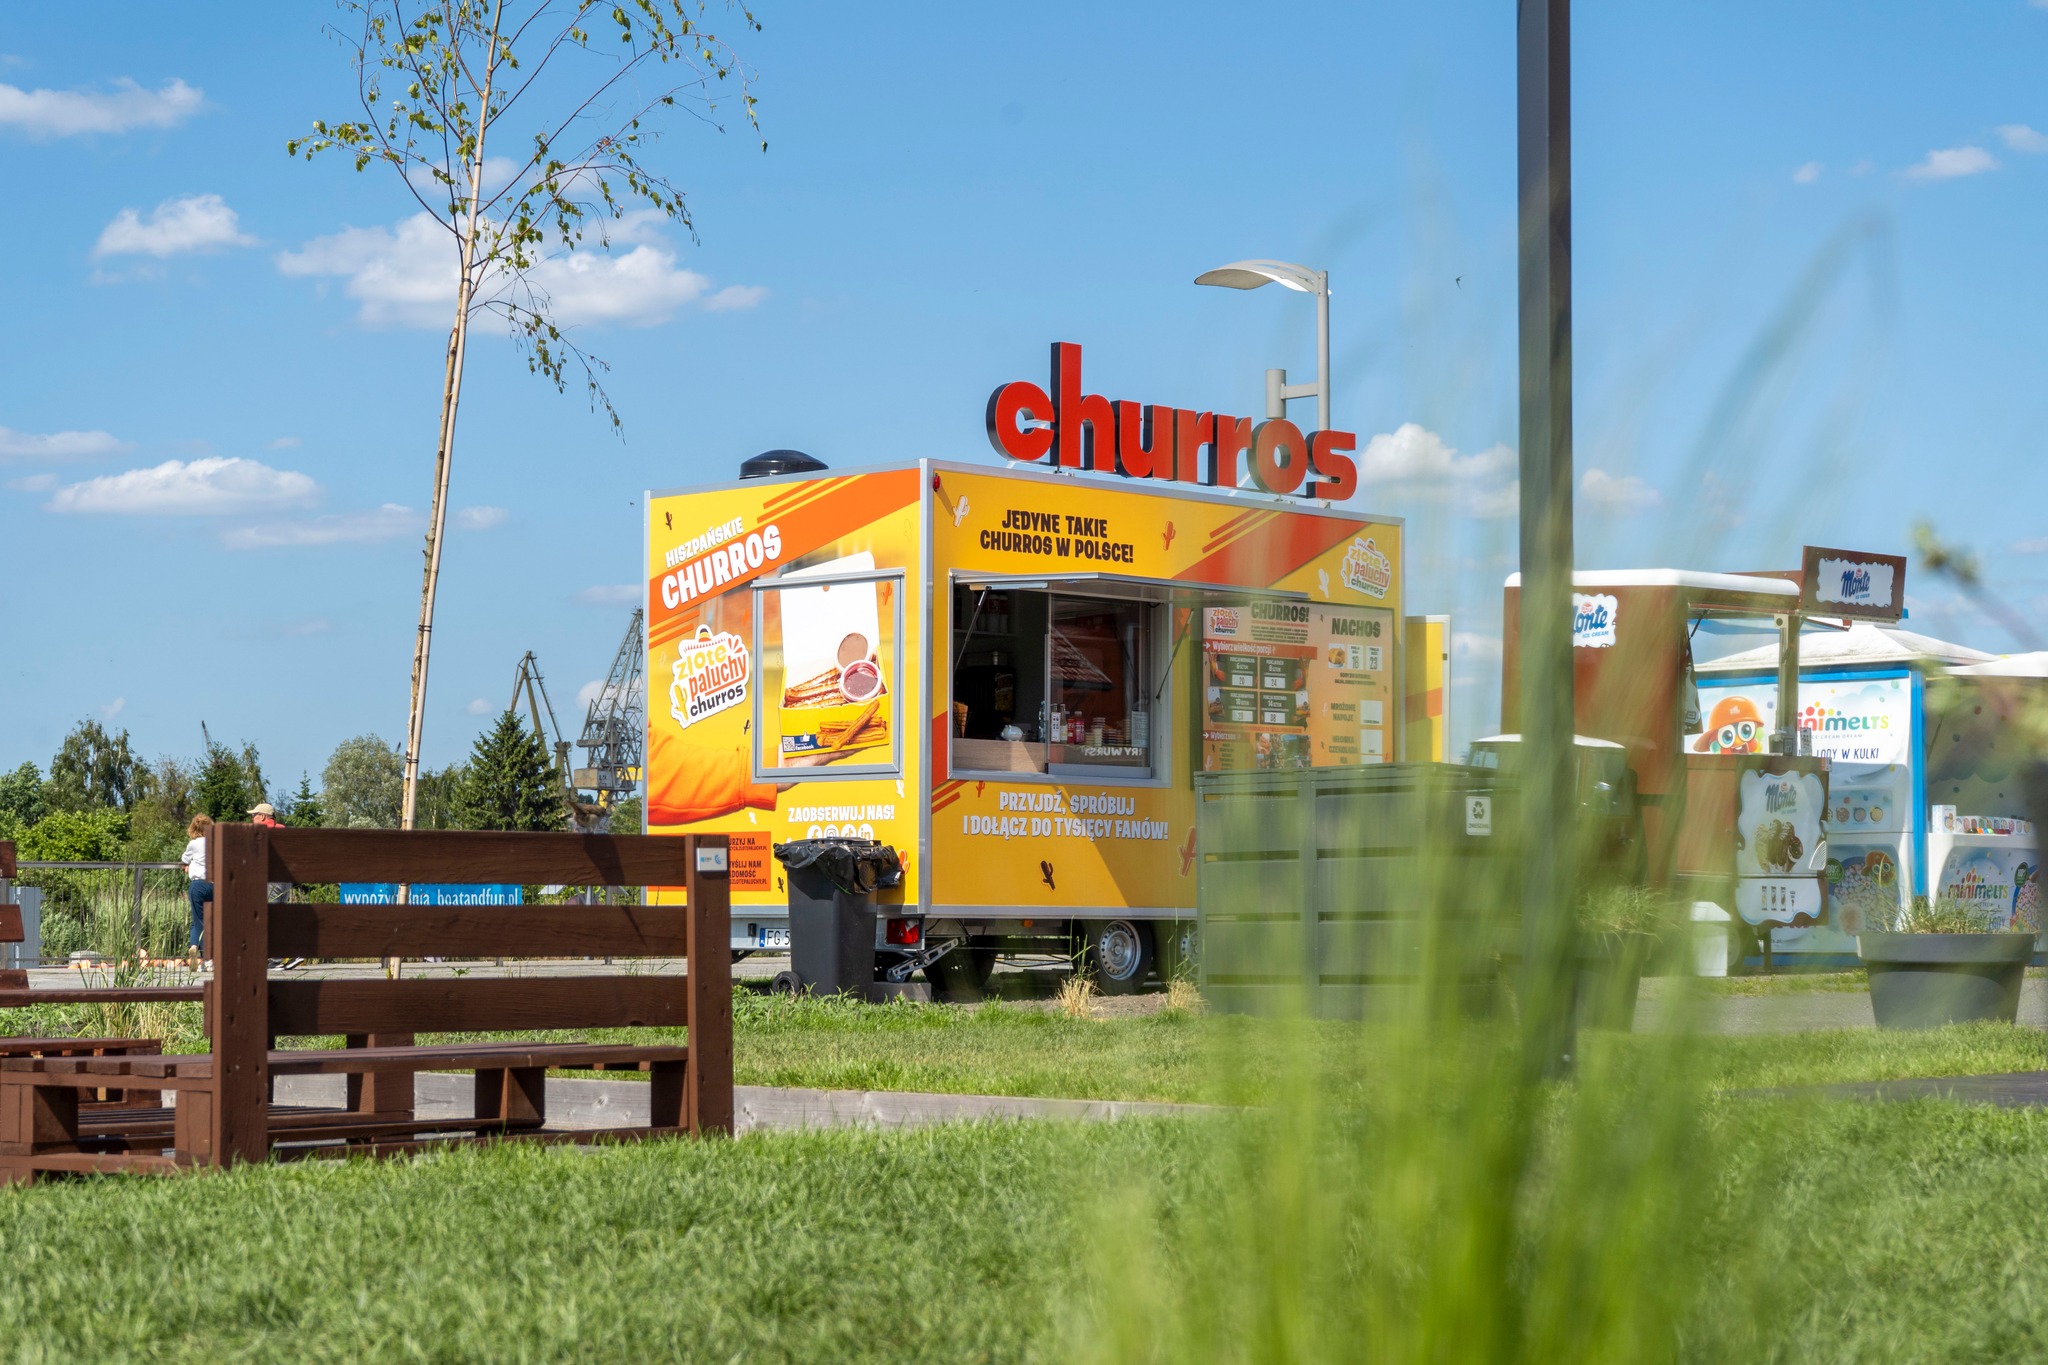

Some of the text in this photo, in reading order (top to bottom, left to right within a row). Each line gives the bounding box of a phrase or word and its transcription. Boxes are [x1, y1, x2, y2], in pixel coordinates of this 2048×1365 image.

[986, 342, 1357, 500] churros
[1002, 509, 1108, 539] JEDYNE TAKIE
[665, 516, 744, 569] HISZPAŃSKIE
[980, 529, 1134, 564] CHURROS W POLSCE!
[662, 524, 782, 610] CHURROS
[1351, 576, 1384, 596] churros
[1841, 570, 1870, 598] Monte
[1251, 602, 1310, 623] CHURROS!
[1573, 605, 1608, 634] onte
[1331, 618, 1381, 638] NACHOS
[1369, 656, 1378, 670] 23
[689, 654, 747, 702] paluchy
[691, 684, 744, 716] churros
[1841, 748, 1850, 760] W
[1853, 748, 1879, 760] KULKI
[788, 805, 894, 822] ZAOBSERWUJ NAS!
[999, 790, 1135, 816] PRZYJDŹ, SPRÓBUJ
[963, 815, 1169, 841] I DOŁĄCZ DO TYSIĘCY FANÓW!
[747, 837, 756, 846] NA
[730, 859, 762, 868] YŚLIJ NAM
[730, 868, 757, 878] DOMOŚĆ
[437, 888, 518, 905] boatandfun.pl
[767, 930, 790, 945] FG 5
